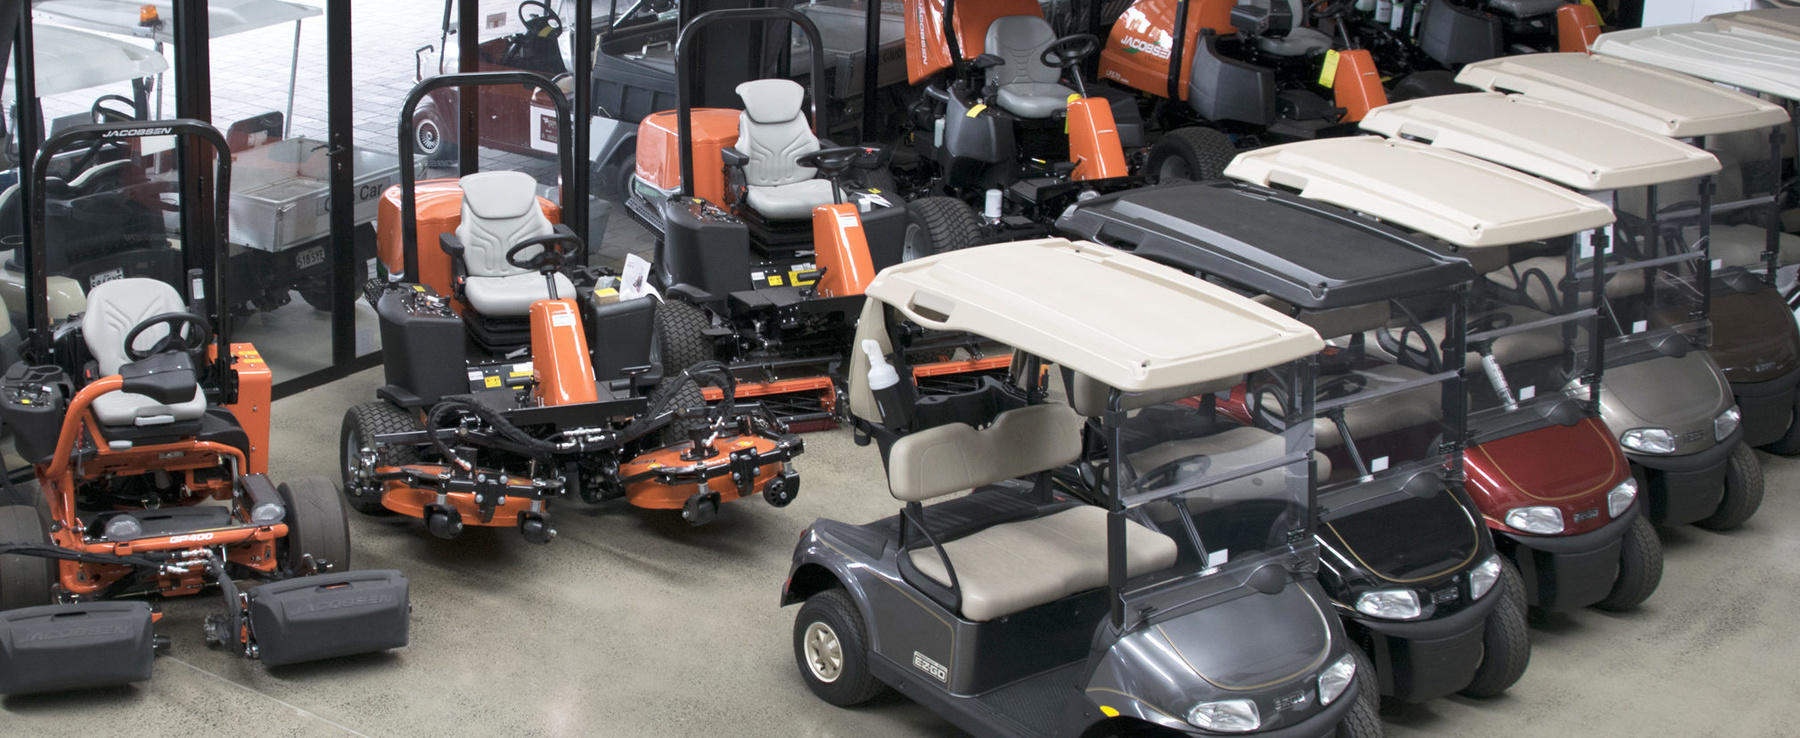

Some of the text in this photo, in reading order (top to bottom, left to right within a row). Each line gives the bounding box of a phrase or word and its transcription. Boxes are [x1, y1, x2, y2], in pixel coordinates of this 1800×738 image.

[102, 127, 172, 138] JACOBSEN
[359, 183, 384, 201] Car
[169, 532, 214, 544] GP400
[292, 593, 394, 616] JACOBSEN
[20, 625, 131, 644] JACOBSEN
[914, 656, 946, 680] EZGO
